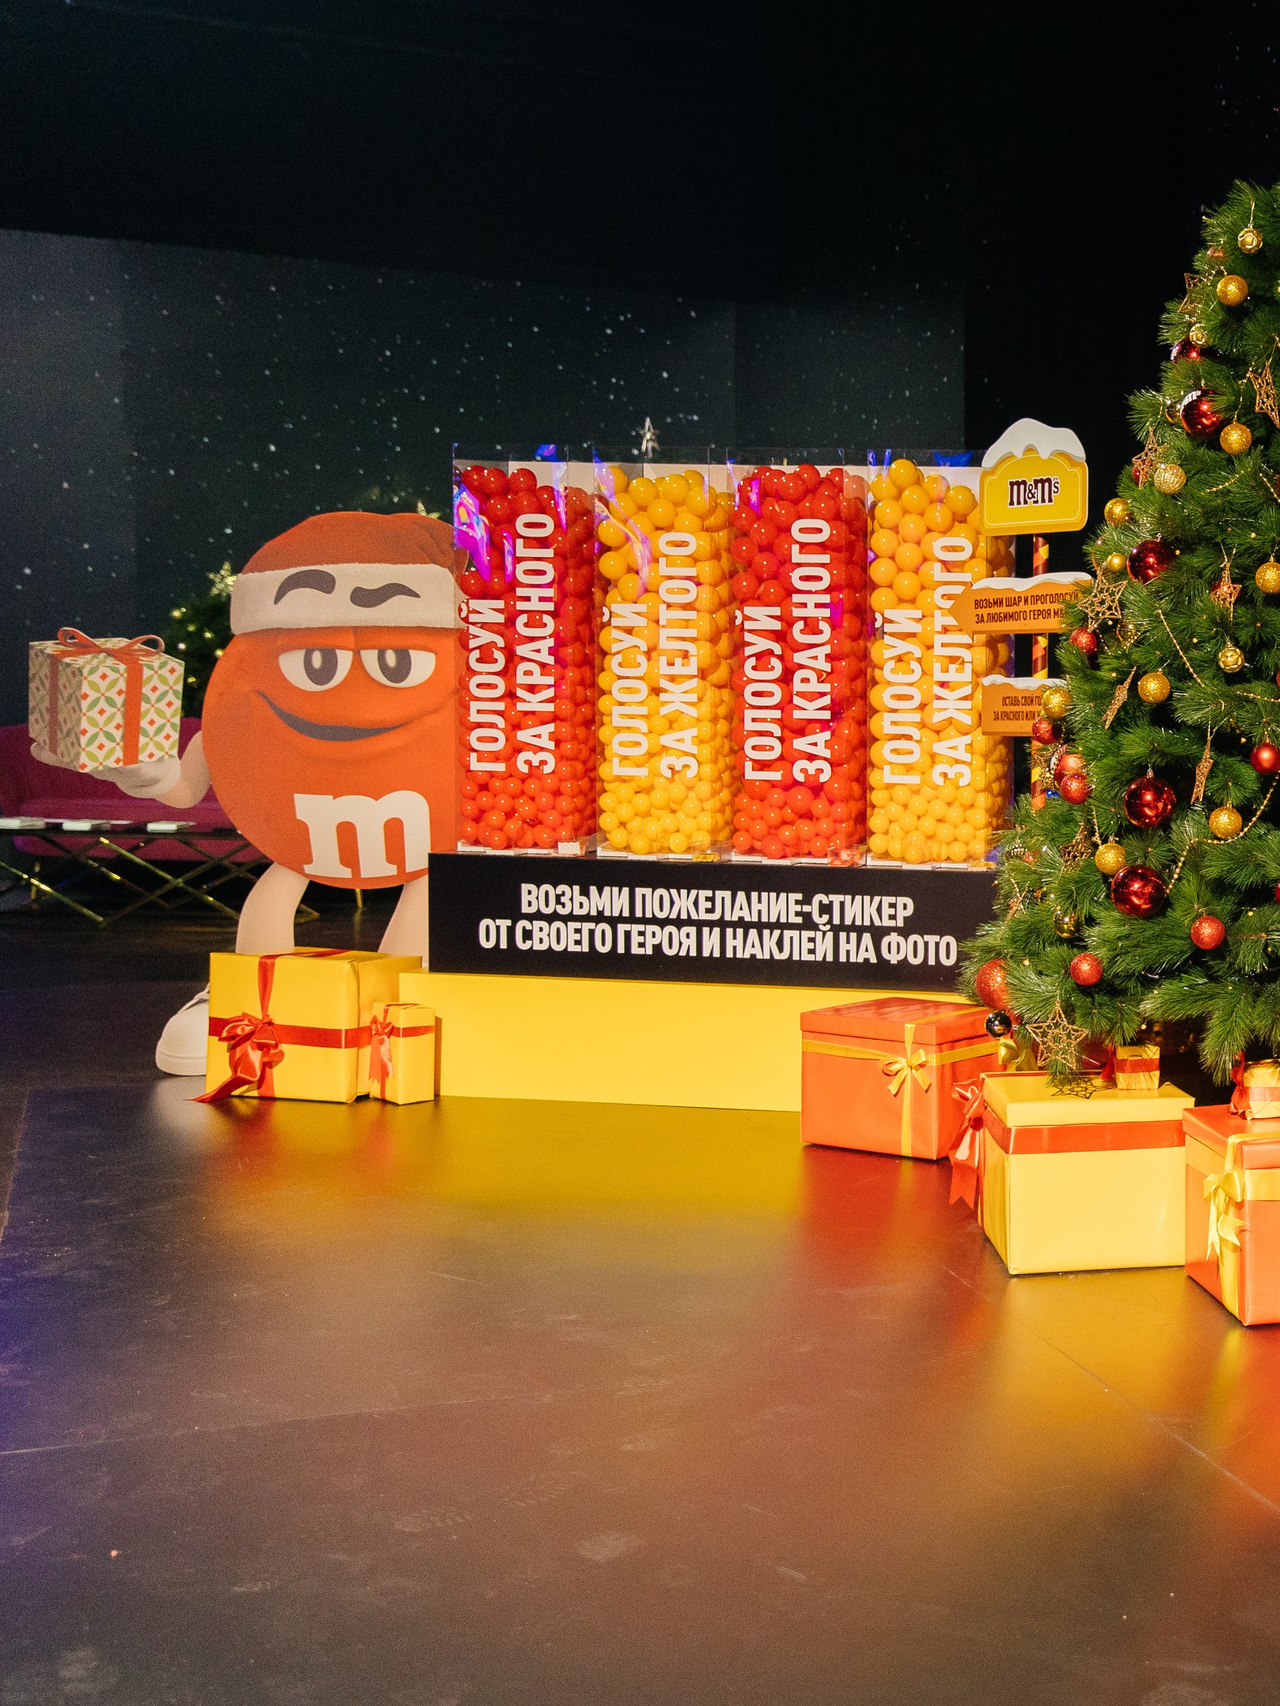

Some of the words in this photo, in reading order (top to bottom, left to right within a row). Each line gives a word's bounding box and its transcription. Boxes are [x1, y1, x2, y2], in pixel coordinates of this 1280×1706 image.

[515, 514, 554, 711] КРАСНОГО
[659, 532, 698, 717] ЖЕЛТОГО
[789, 519, 831, 719] КРАСНОГО
[974, 597, 1004, 610] ВОЗЬМИ
[1005, 595, 1022, 607] ШАР
[1024, 595, 1029, 606] И
[975, 613, 985, 624] ЗА
[986, 610, 1027, 623] ЛЮБИМОГО
[1029, 608, 1051, 620] ГЕРОЯ
[932, 537, 972, 725] ЖЕЛТОГО
[460, 599, 505, 771] ГОЛОСУЙ
[602, 603, 648, 776] ГОЛОСУЙ
[735, 606, 782, 780] ГОЛОСУЙ
[874, 609, 922, 784] ГОЛОСУЙ
[1002, 695, 1020, 706] ОСТАВЬ
[1021, 693, 1034, 706] СВОЙ
[993, 711, 999, 721] ЗА
[1000, 711, 1024, 721] КРАСНОГО
[516, 723, 555, 774] ЗА
[659, 728, 697, 778] ЗА
[792, 731, 831, 782] ЗА
[932, 735, 972, 786] ЗА
[293, 790, 430, 878] m
[521, 883, 630, 917] ВОЗЬМИ
[635, 888, 915, 927] ПОЖЕЛАНИЕ-СТИКЕР
[478, 918, 512, 949] ОТ
[515, 919, 613, 954] СВОЕГО
[618, 923, 697, 957] ГЕРОЯ
[702, 926, 721, 958] И
[725, 925, 834, 962] НАКЛЕЙ
[839, 931, 878, 964] НА
[880, 931, 958, 967] ФОТО
